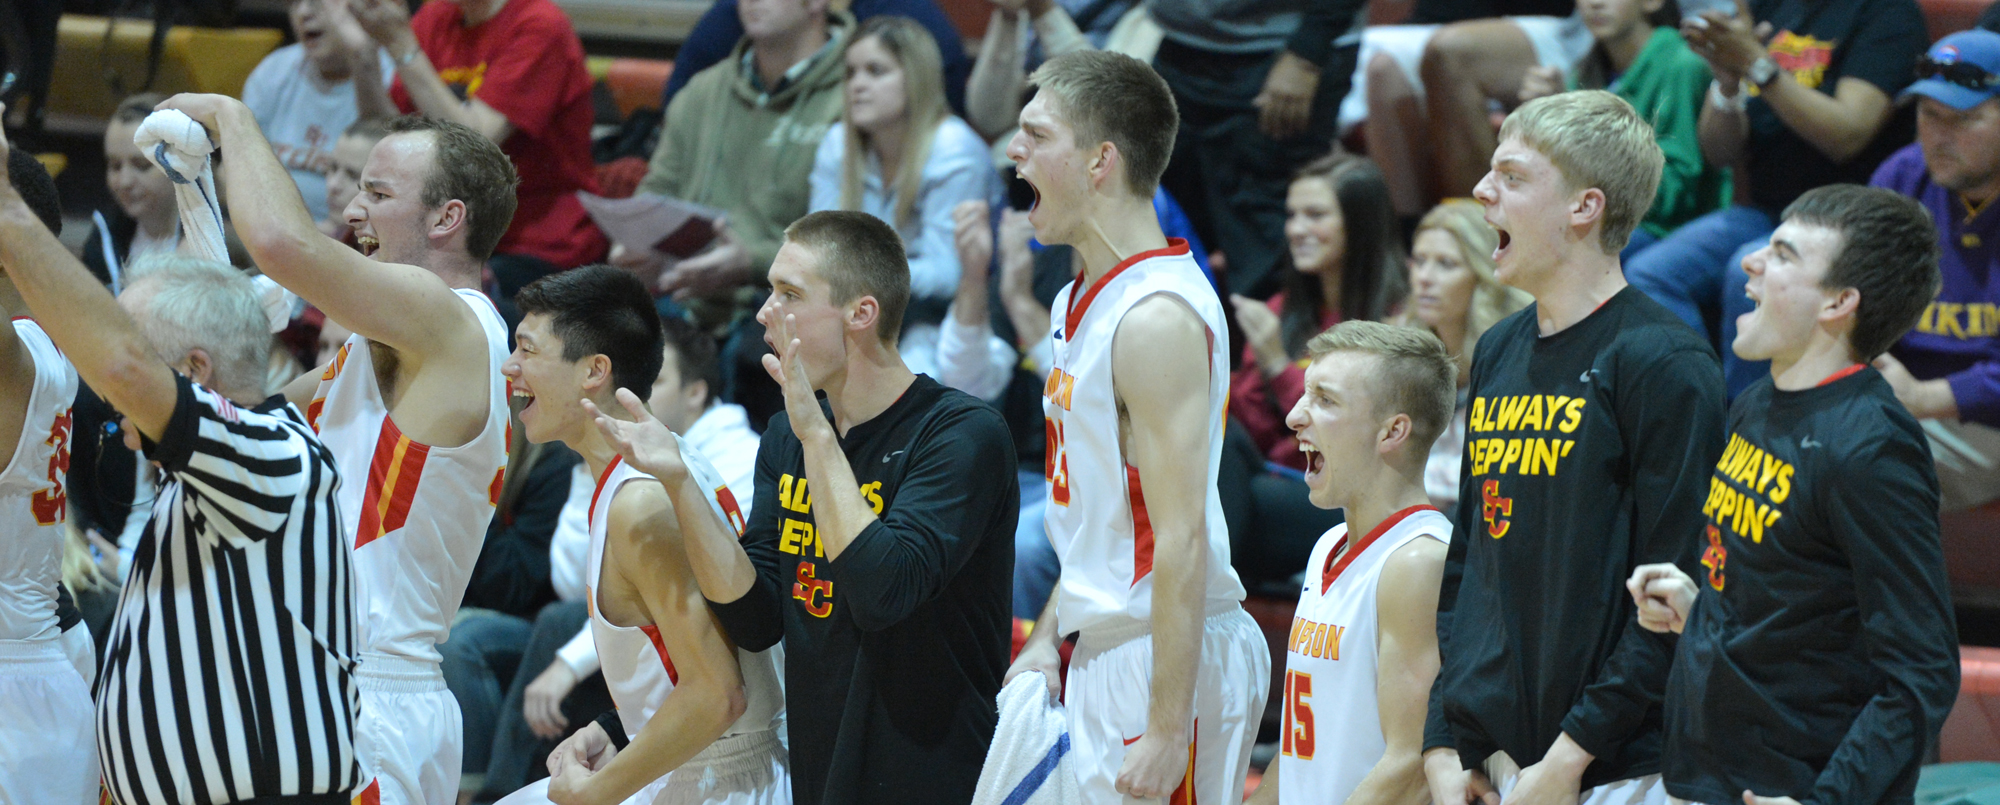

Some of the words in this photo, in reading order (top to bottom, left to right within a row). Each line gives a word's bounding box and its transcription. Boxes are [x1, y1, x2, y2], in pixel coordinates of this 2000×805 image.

[1916, 301, 2000, 340] IKIN
[1469, 394, 1587, 434] ALWAYS
[1482, 479, 1513, 540] SC
[792, 561, 833, 619] SC
[1282, 668, 1316, 761] 15
